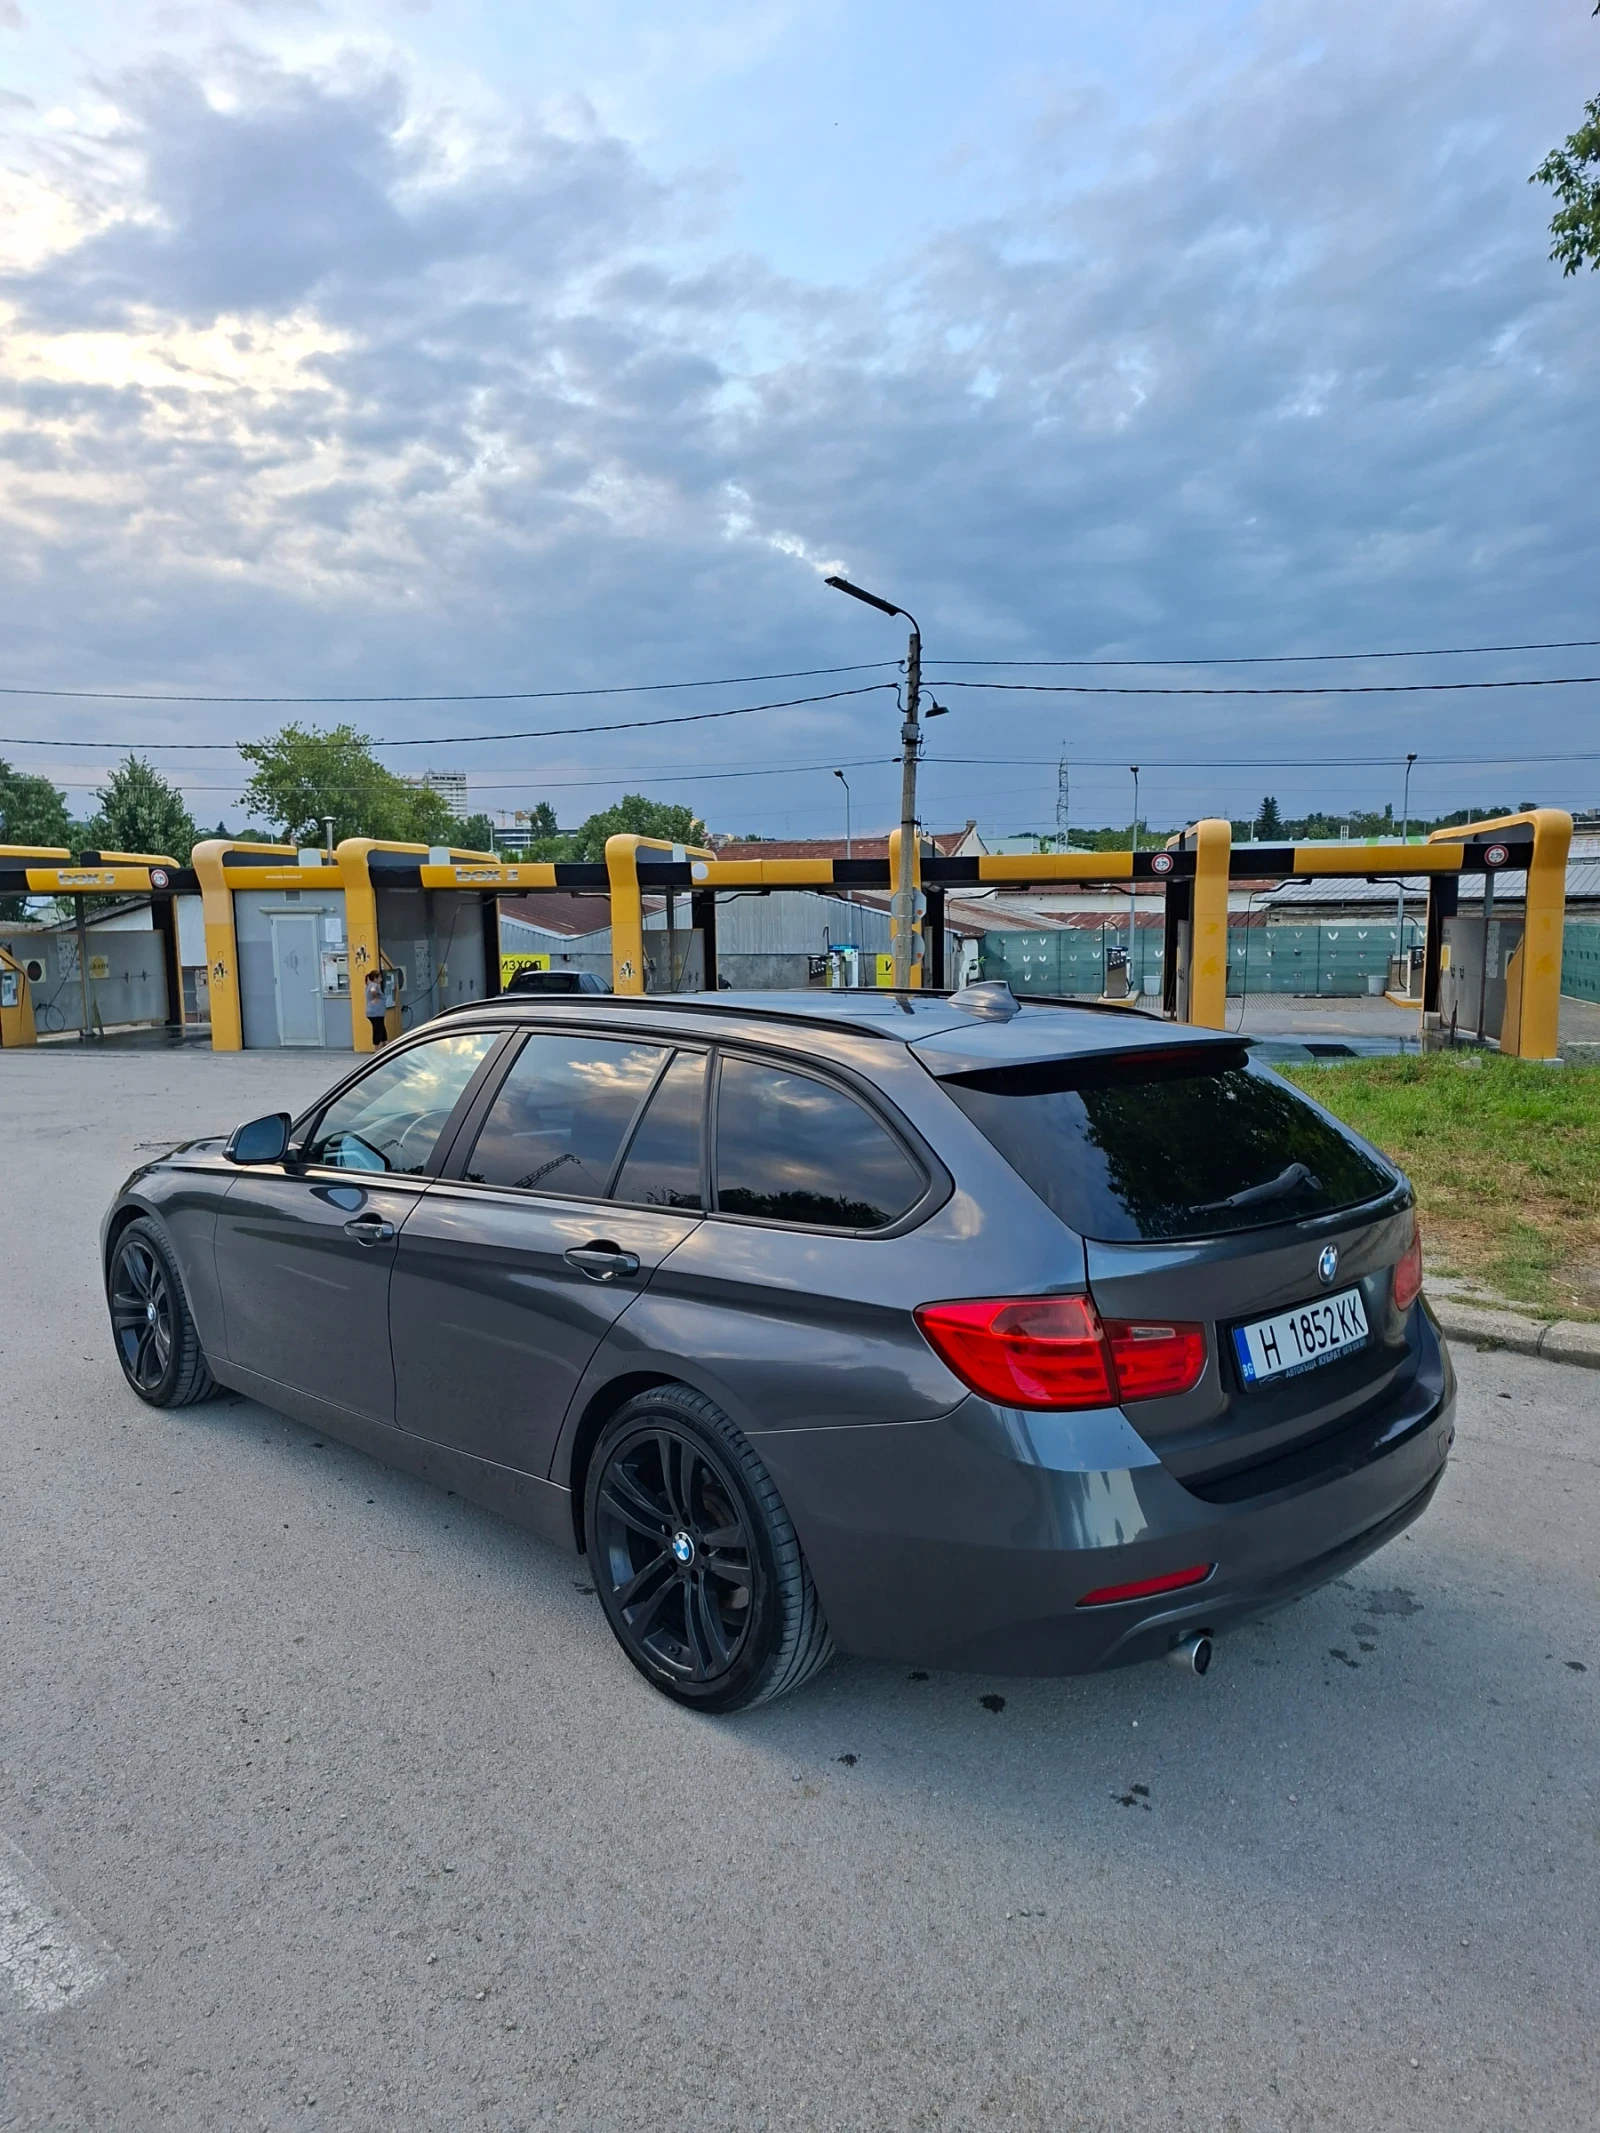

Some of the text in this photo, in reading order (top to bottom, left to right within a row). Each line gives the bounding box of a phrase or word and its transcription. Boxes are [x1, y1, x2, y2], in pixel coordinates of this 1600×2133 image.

[57, 869, 101, 885] box
[455, 866, 519, 881] box 2
[1259, 1325, 1282, 1370] H
[1242, 1362, 1254, 1377] BG
